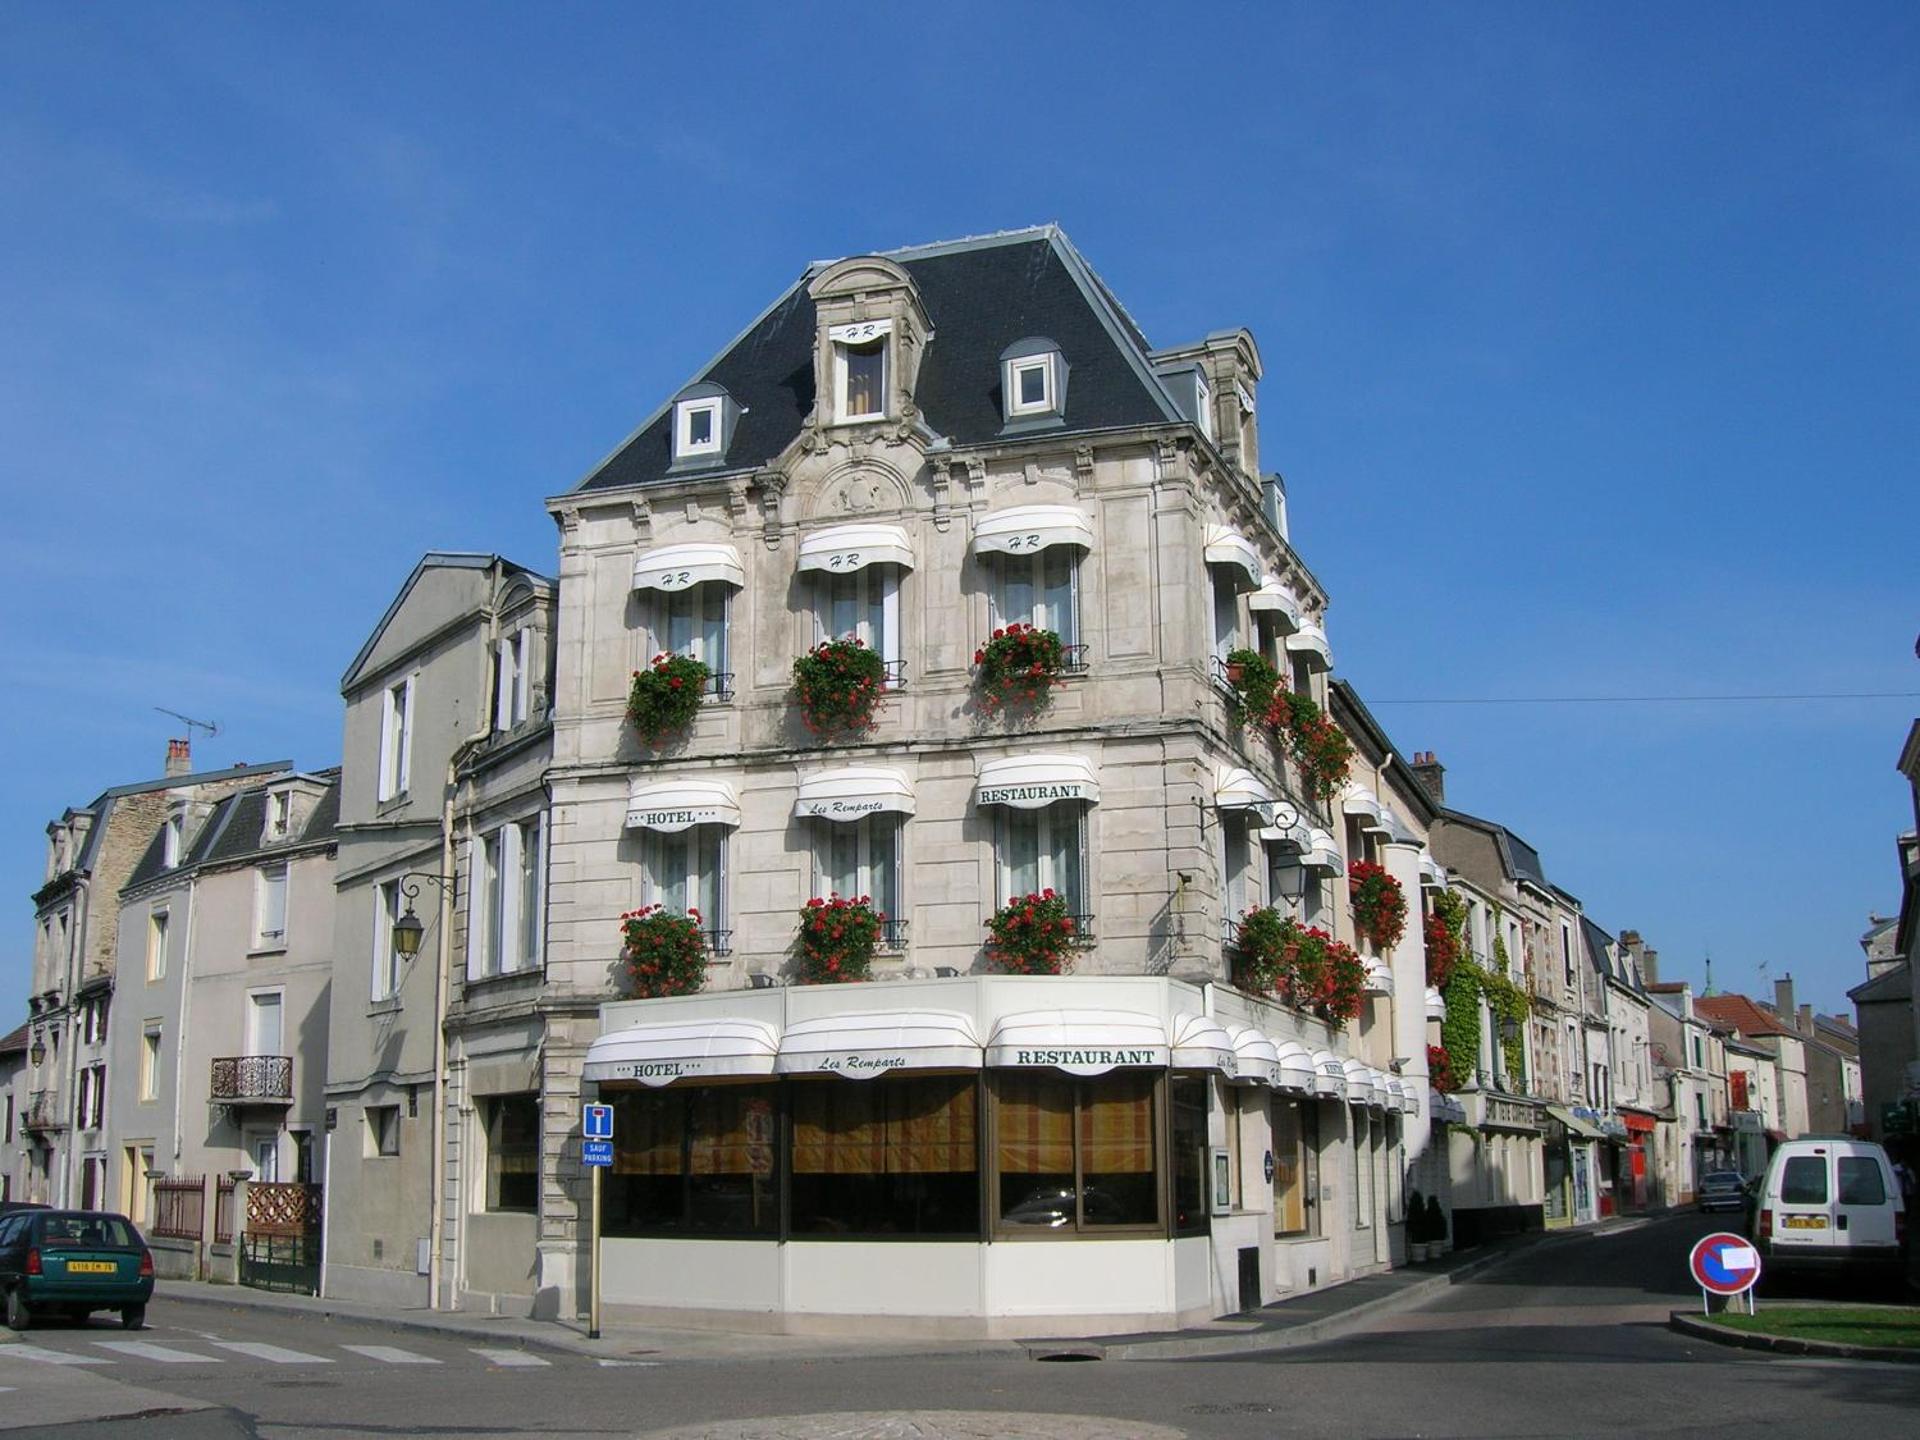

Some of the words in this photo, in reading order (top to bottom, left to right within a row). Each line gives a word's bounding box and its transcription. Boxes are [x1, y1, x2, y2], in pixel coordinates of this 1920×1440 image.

[981, 785, 1081, 803] RESTAURANT
[809, 803, 827, 815] Les
[832, 801, 884, 814] Remparts
[647, 811, 696, 825] HOTEL
[818, 1056, 840, 1070] Les
[847, 1056, 905, 1070] Remparts
[1017, 1050, 1155, 1064] RESTAURANT
[633, 1063, 684, 1077] HOTEL
